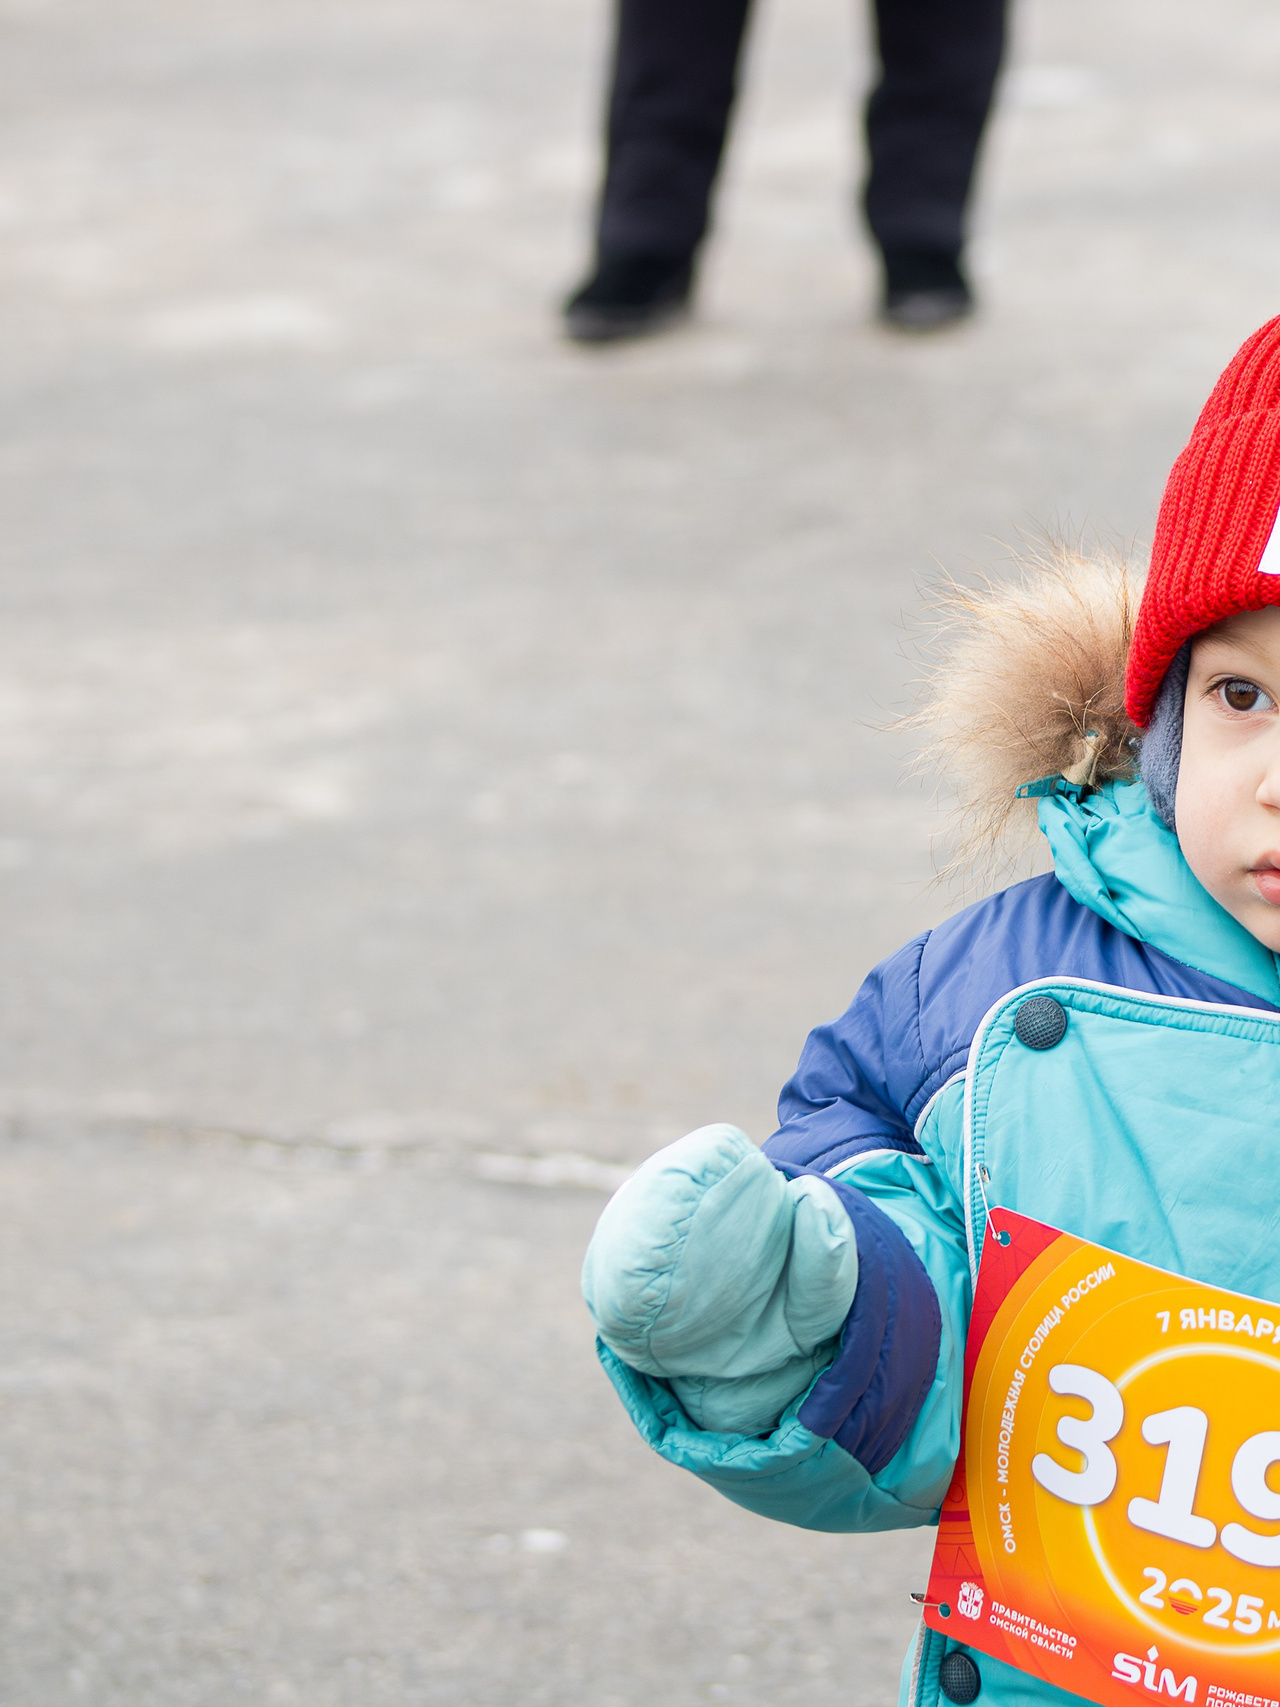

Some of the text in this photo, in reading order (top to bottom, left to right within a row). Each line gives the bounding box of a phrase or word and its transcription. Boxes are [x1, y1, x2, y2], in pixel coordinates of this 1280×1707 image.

[1060, 1262, 1116, 1310] РОССИИ
[1020, 1305, 1065, 1369] СТОЛИЦА
[1155, 1310, 1171, 1334] 7
[997, 1369, 1027, 1484] МОЛОДЕЖНАЯ
[999, 1502, 1017, 1554] ОМСК
[989, 1614, 1073, 1659] ОМСКОЙ ОБЛАСТИ
[991, 1601, 1077, 1647] ПРАВИТЕЛЬСТВО
